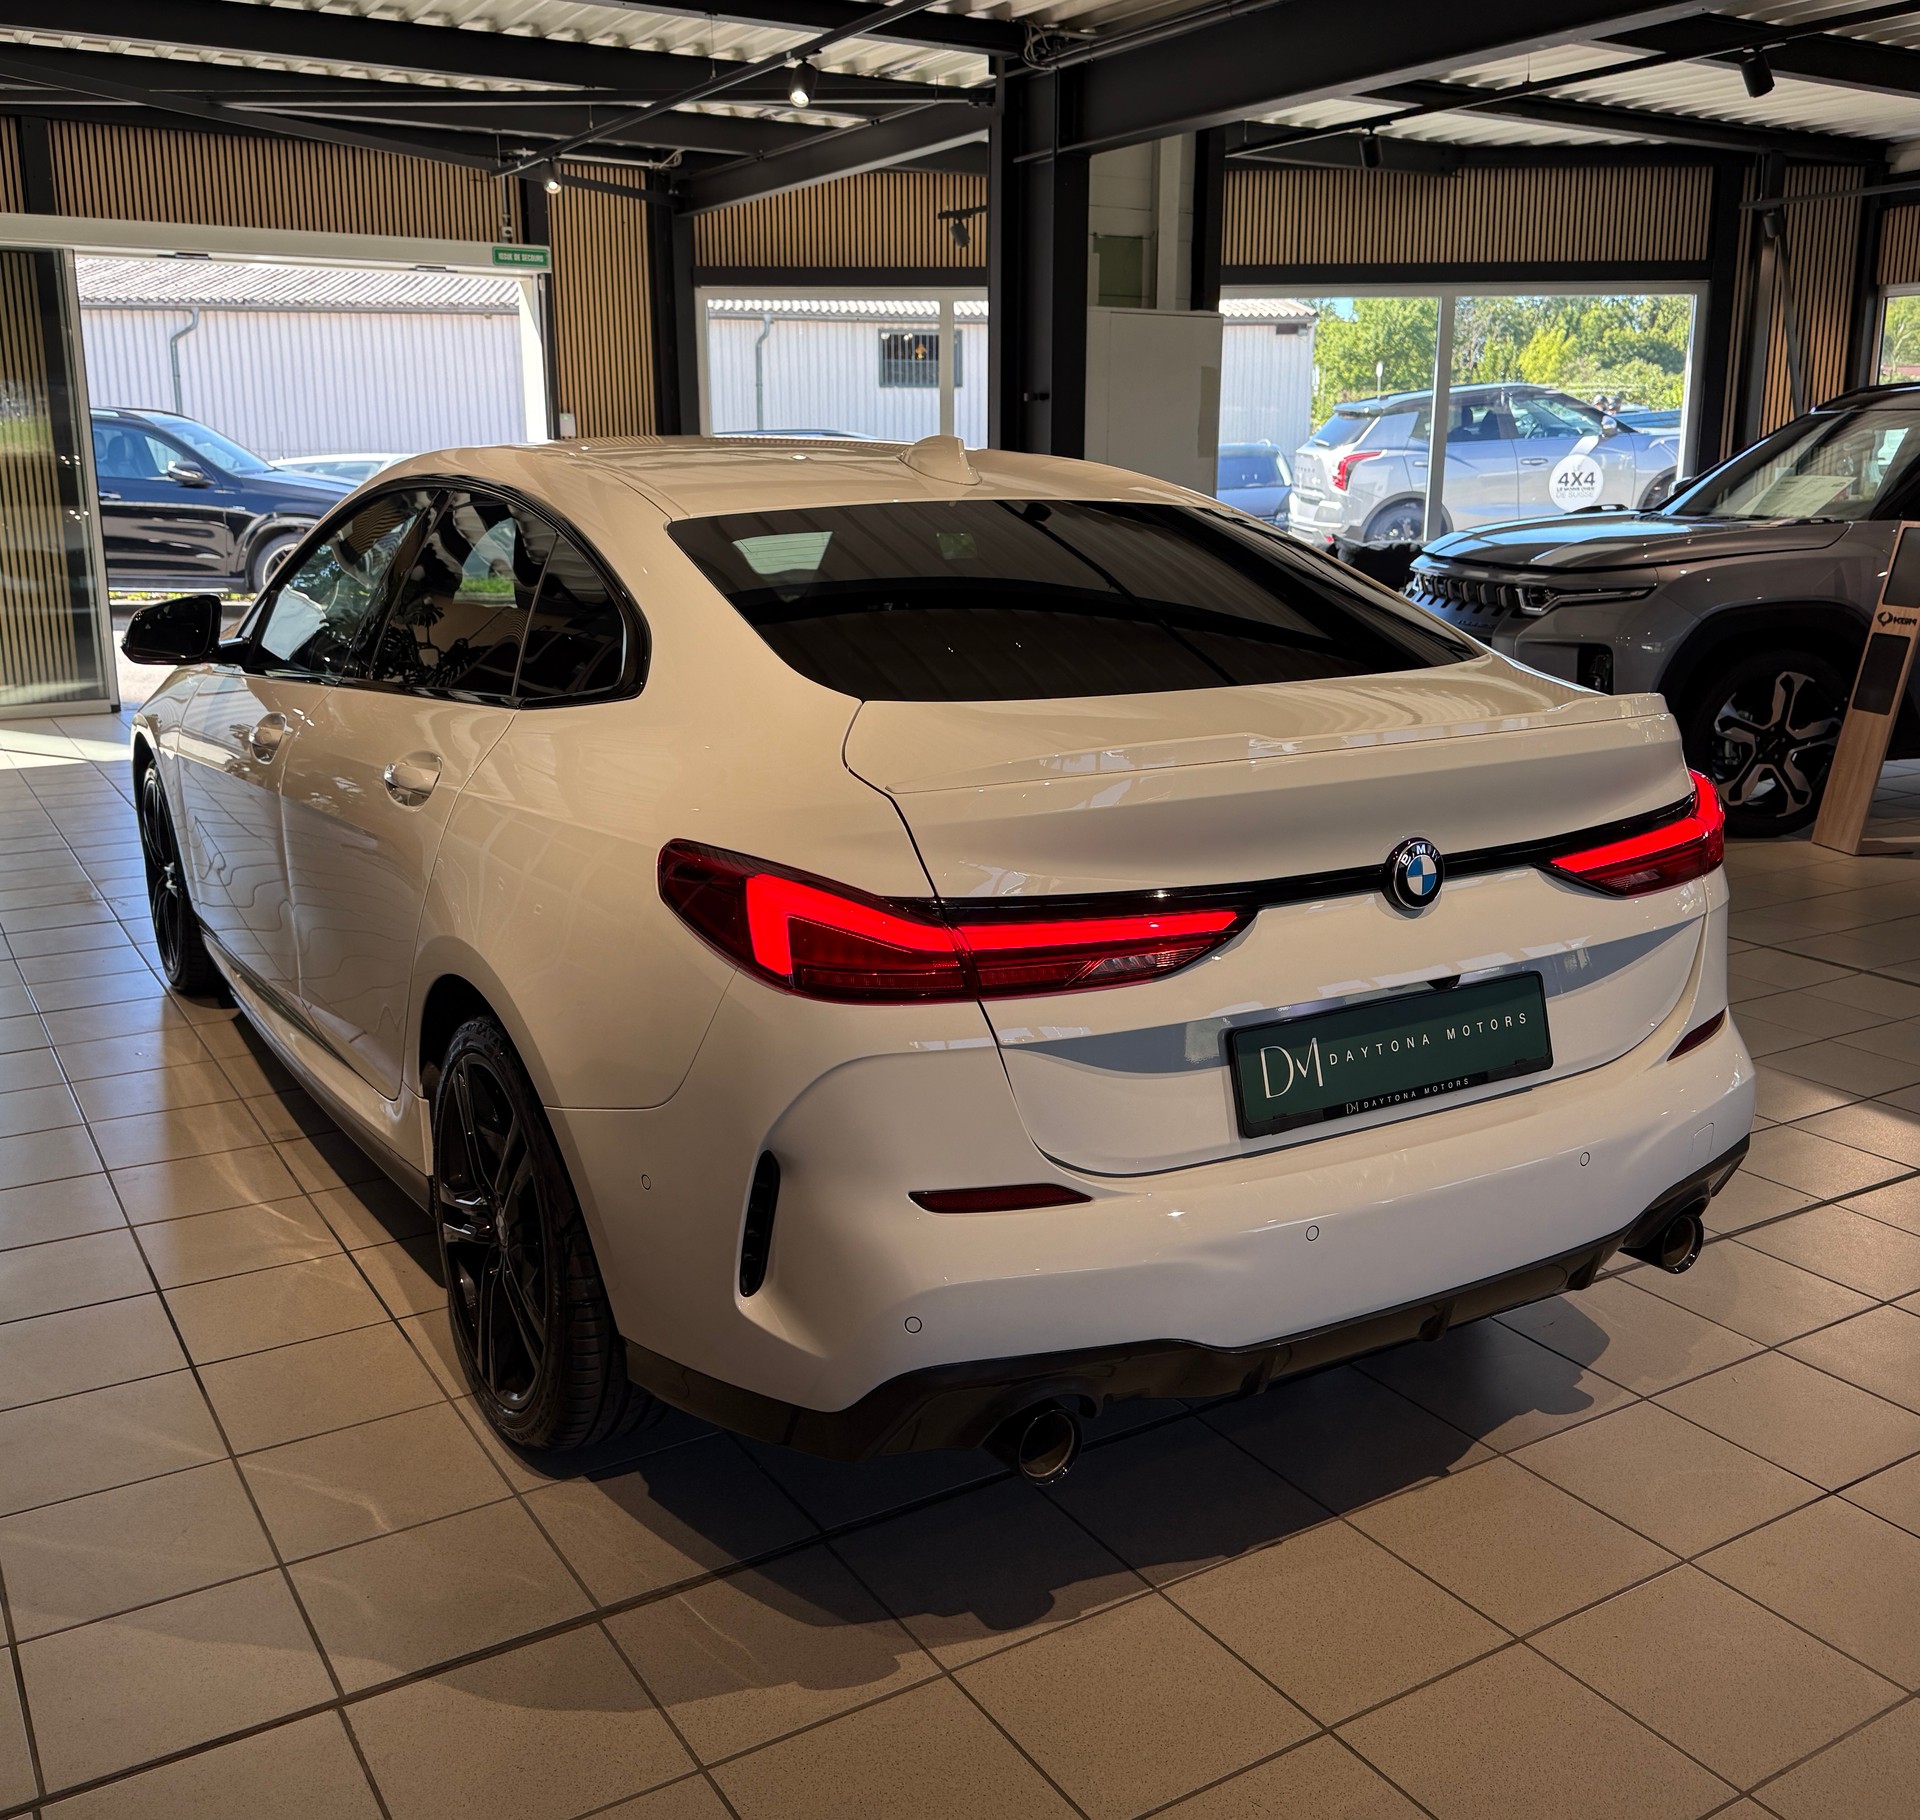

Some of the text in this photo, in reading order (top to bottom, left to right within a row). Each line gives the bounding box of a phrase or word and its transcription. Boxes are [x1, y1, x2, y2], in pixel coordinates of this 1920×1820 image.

[1558, 472, 1595, 487] 4X4
[1330, 1033, 1431, 1066] DAYTONA
[1447, 1012, 1527, 1040] MOTORS
[1364, 1091, 1417, 1109] DAYTONA
[1424, 1078, 1470, 1095] MOTORS
